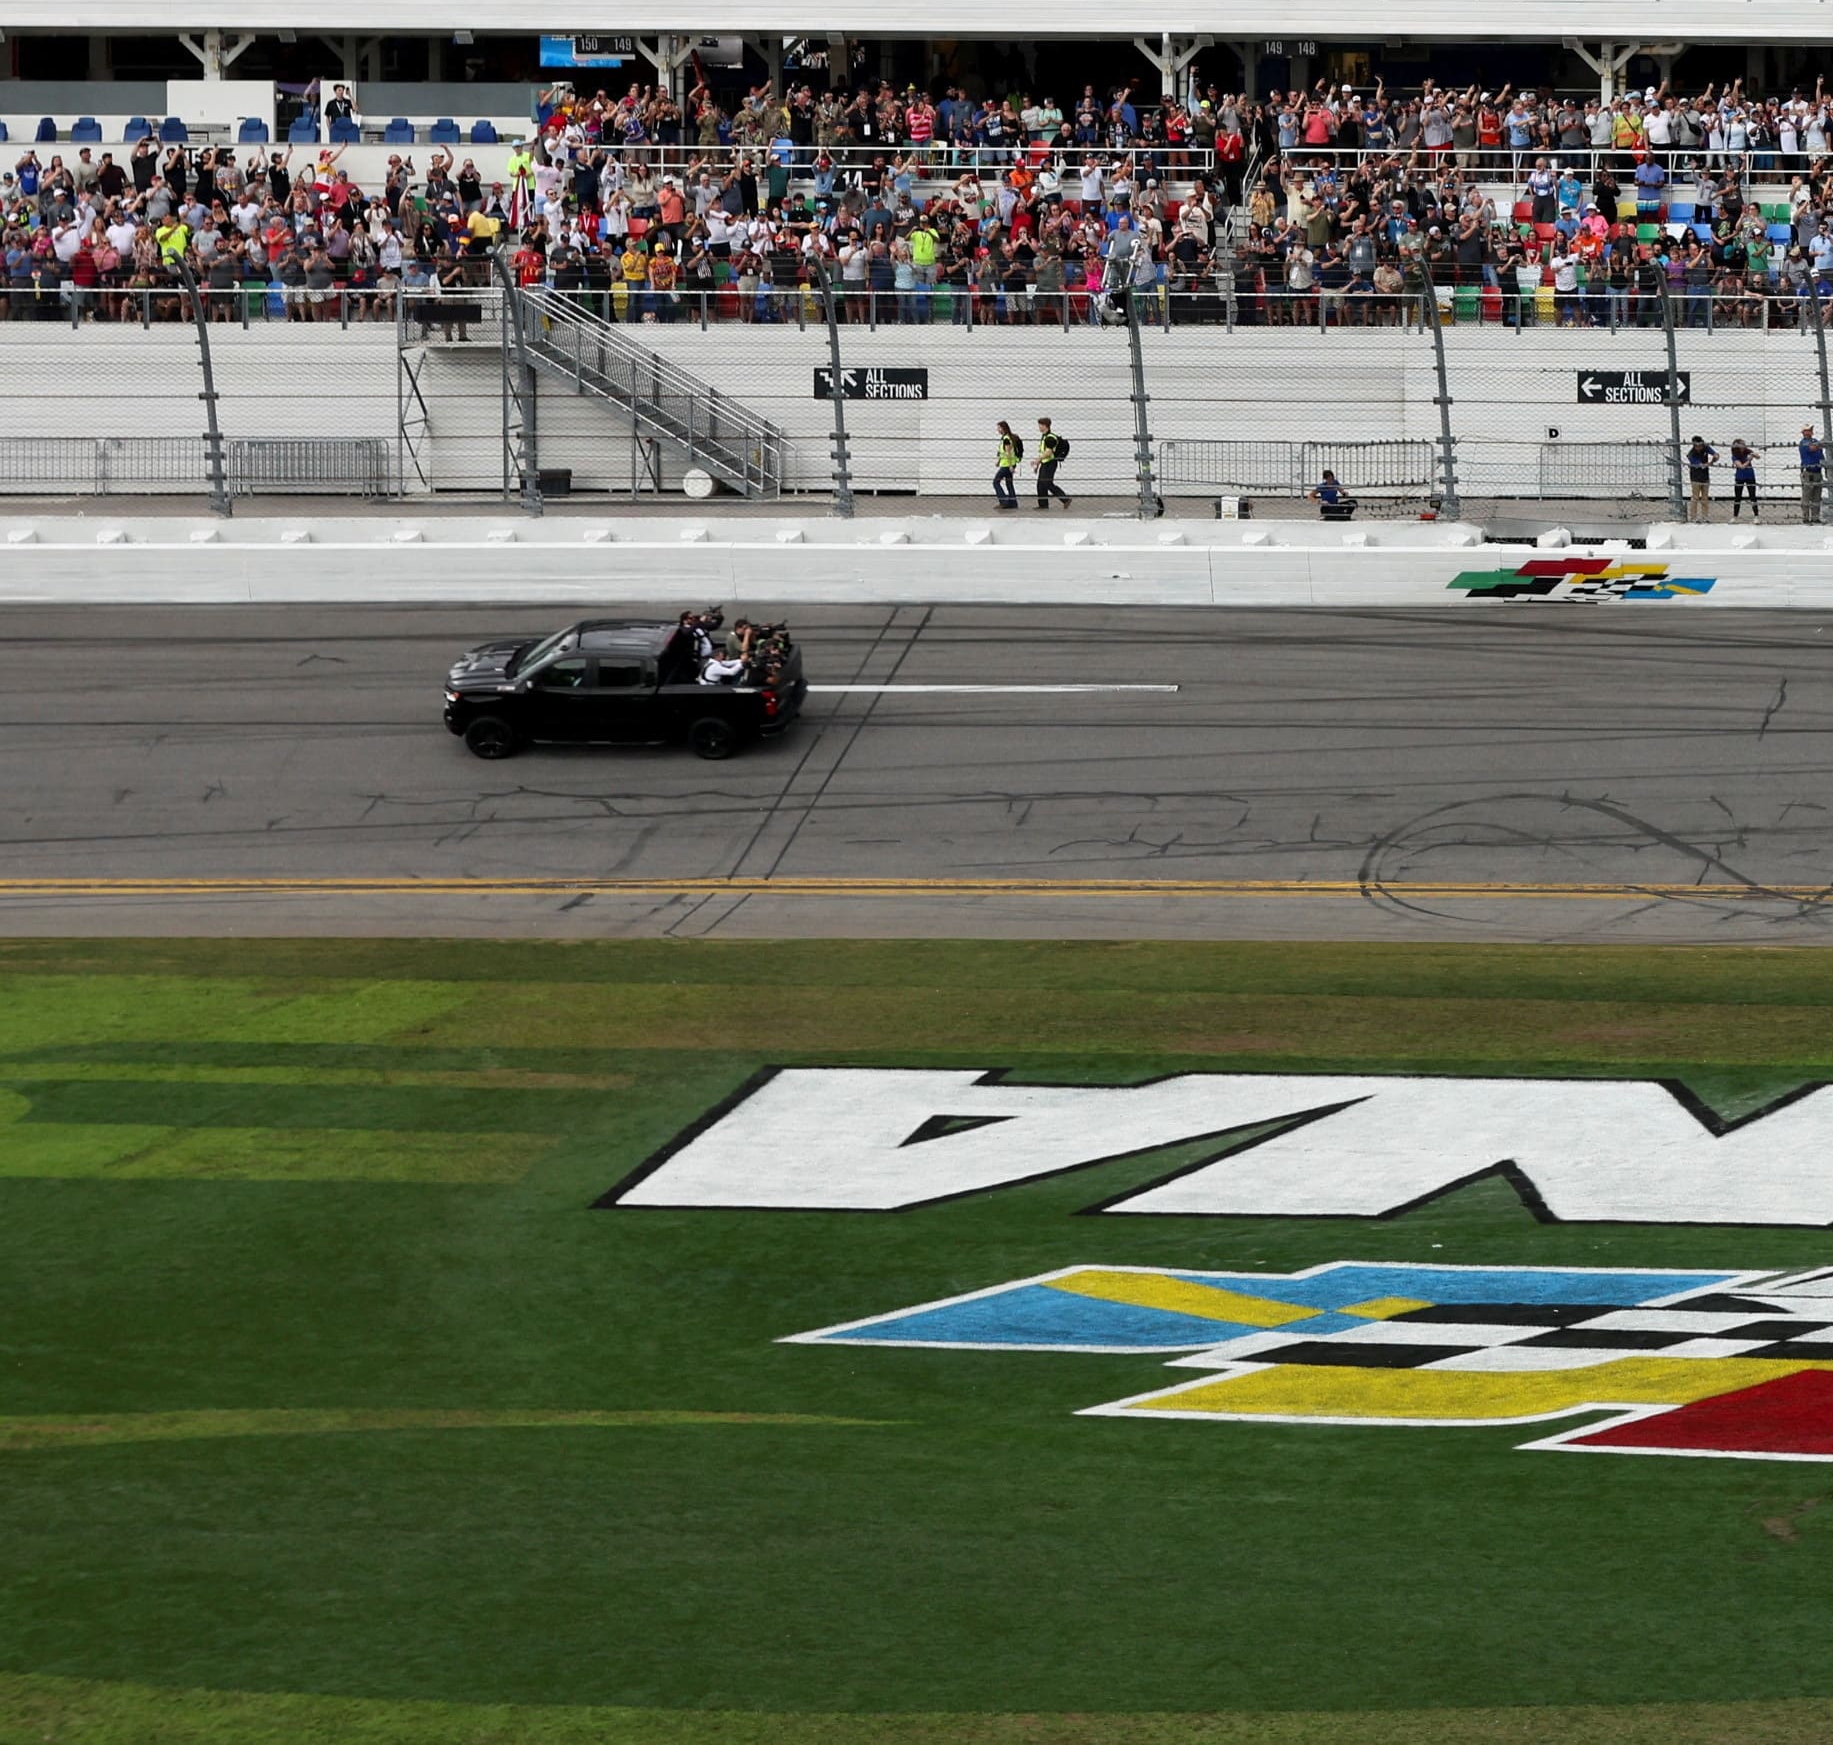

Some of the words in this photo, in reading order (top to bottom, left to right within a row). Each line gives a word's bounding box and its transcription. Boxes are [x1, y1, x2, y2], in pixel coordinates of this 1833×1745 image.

[580, 37, 598, 51] 150
[614, 38, 632, 51] 149
[1265, 41, 1283, 55] 149
[1298, 41, 1316, 55] 148
[865, 369, 887, 384] ALL
[1623, 372, 1645, 387] ALL
[865, 384, 922, 399] SECTIONS
[1605, 387, 1662, 403] SECTIONS
[1548, 428, 1559, 439] D
